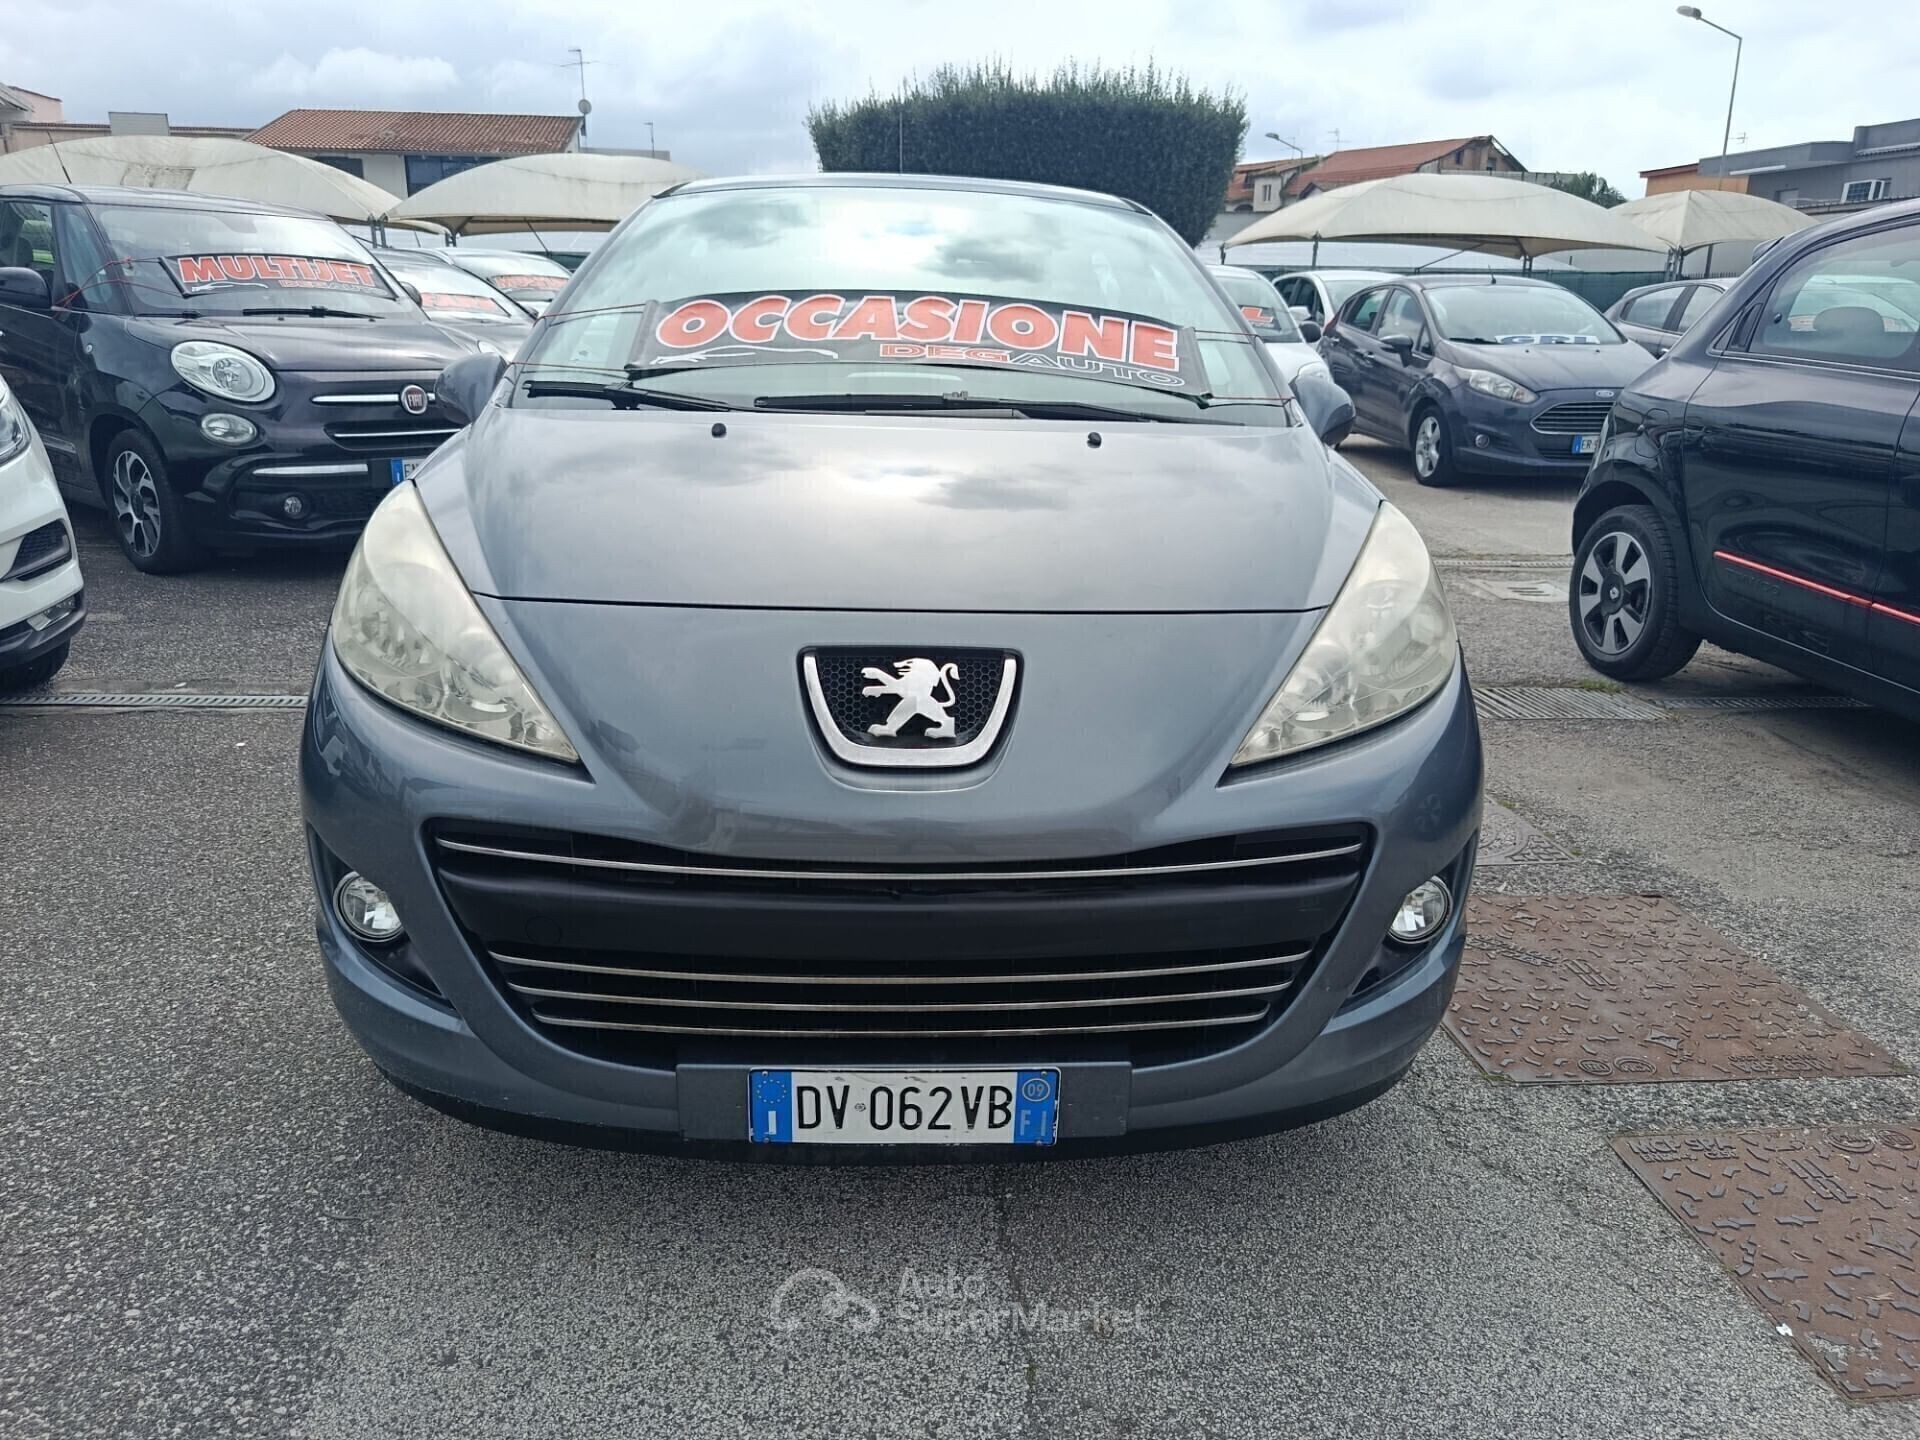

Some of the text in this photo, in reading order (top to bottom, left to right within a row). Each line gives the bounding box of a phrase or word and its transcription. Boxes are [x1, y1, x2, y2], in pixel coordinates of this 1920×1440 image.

[177, 255, 376, 287] MULTIJET
[655, 294, 1180, 372] OCCASIONE
[1026, 1083, 1045, 1097] 09
[796, 1086, 850, 1129] DV
[1020, 1109, 1048, 1137] FI
